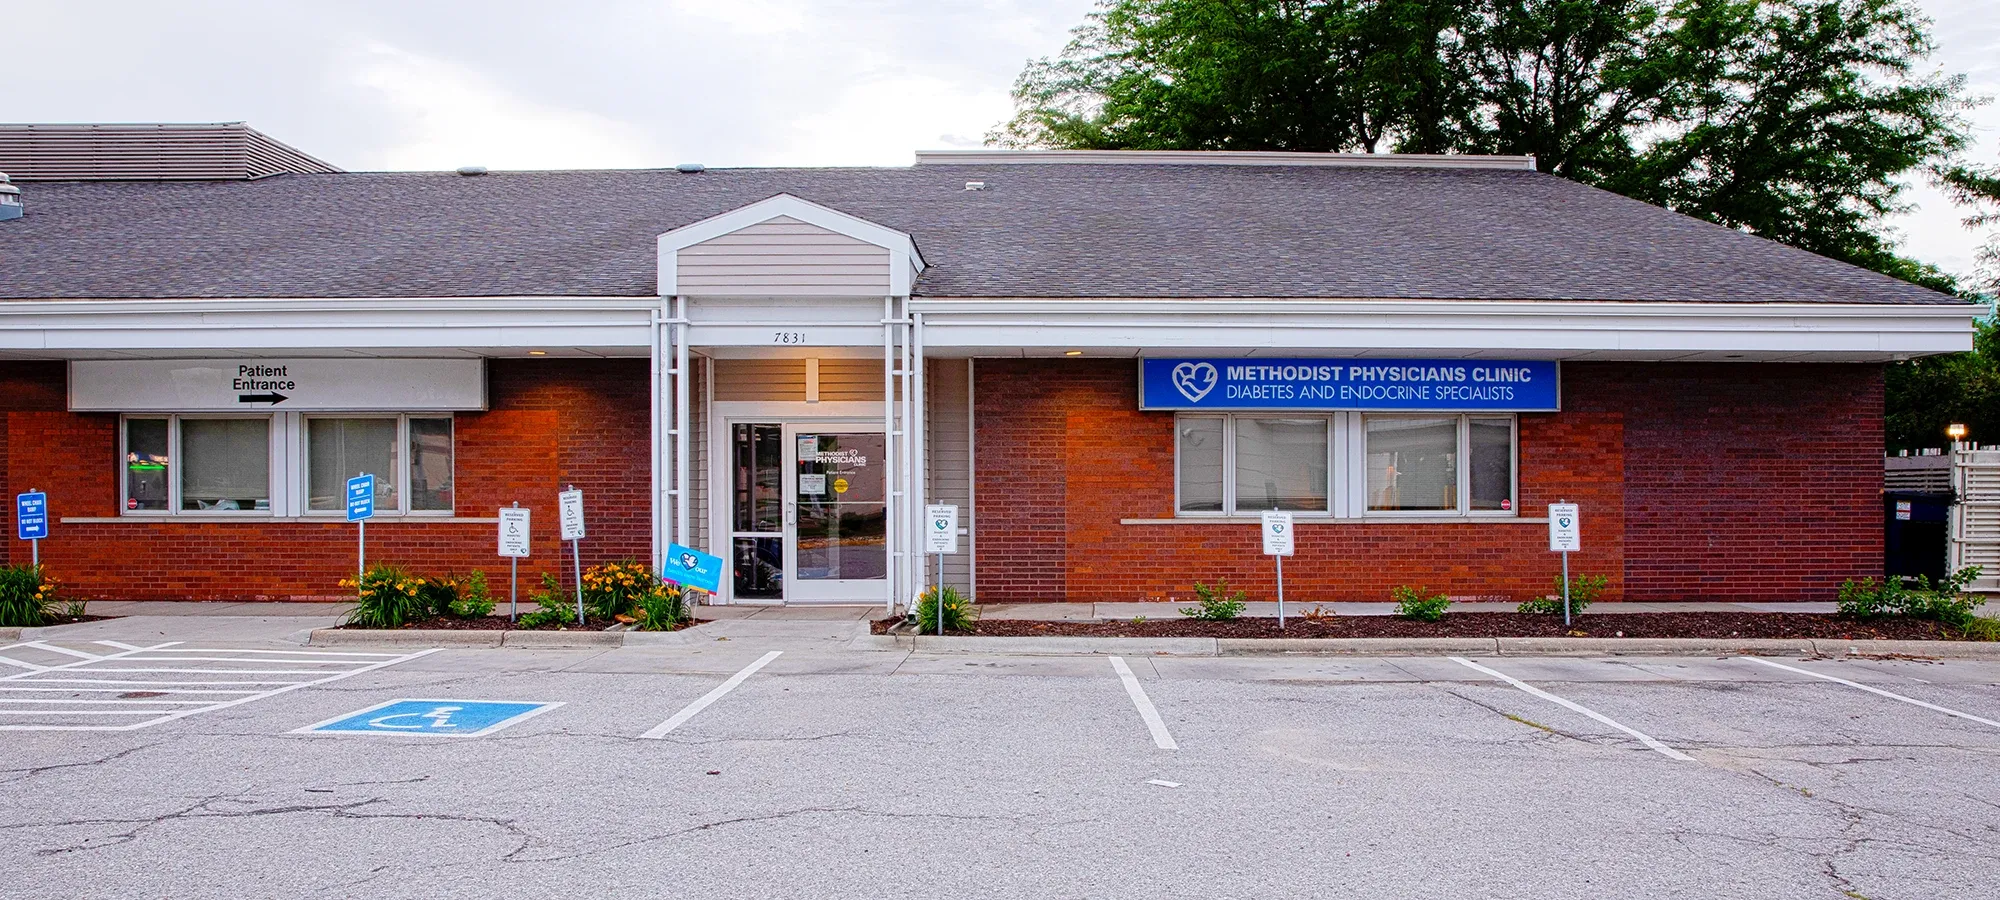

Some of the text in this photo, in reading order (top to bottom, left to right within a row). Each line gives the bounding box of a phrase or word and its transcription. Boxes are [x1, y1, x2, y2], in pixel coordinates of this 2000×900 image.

[773, 332, 805, 344] 7831
[239, 365, 287, 377] Patient
[1227, 366, 1531, 382] METHODIST PHYSICIANS CLINIC
[233, 378, 295, 390] Entrance
[1227, 385, 1514, 400] DIABETES AND ENDOCRINE SPECIALISTS
[669, 557, 681, 567] We
[694, 566, 708, 575] our
